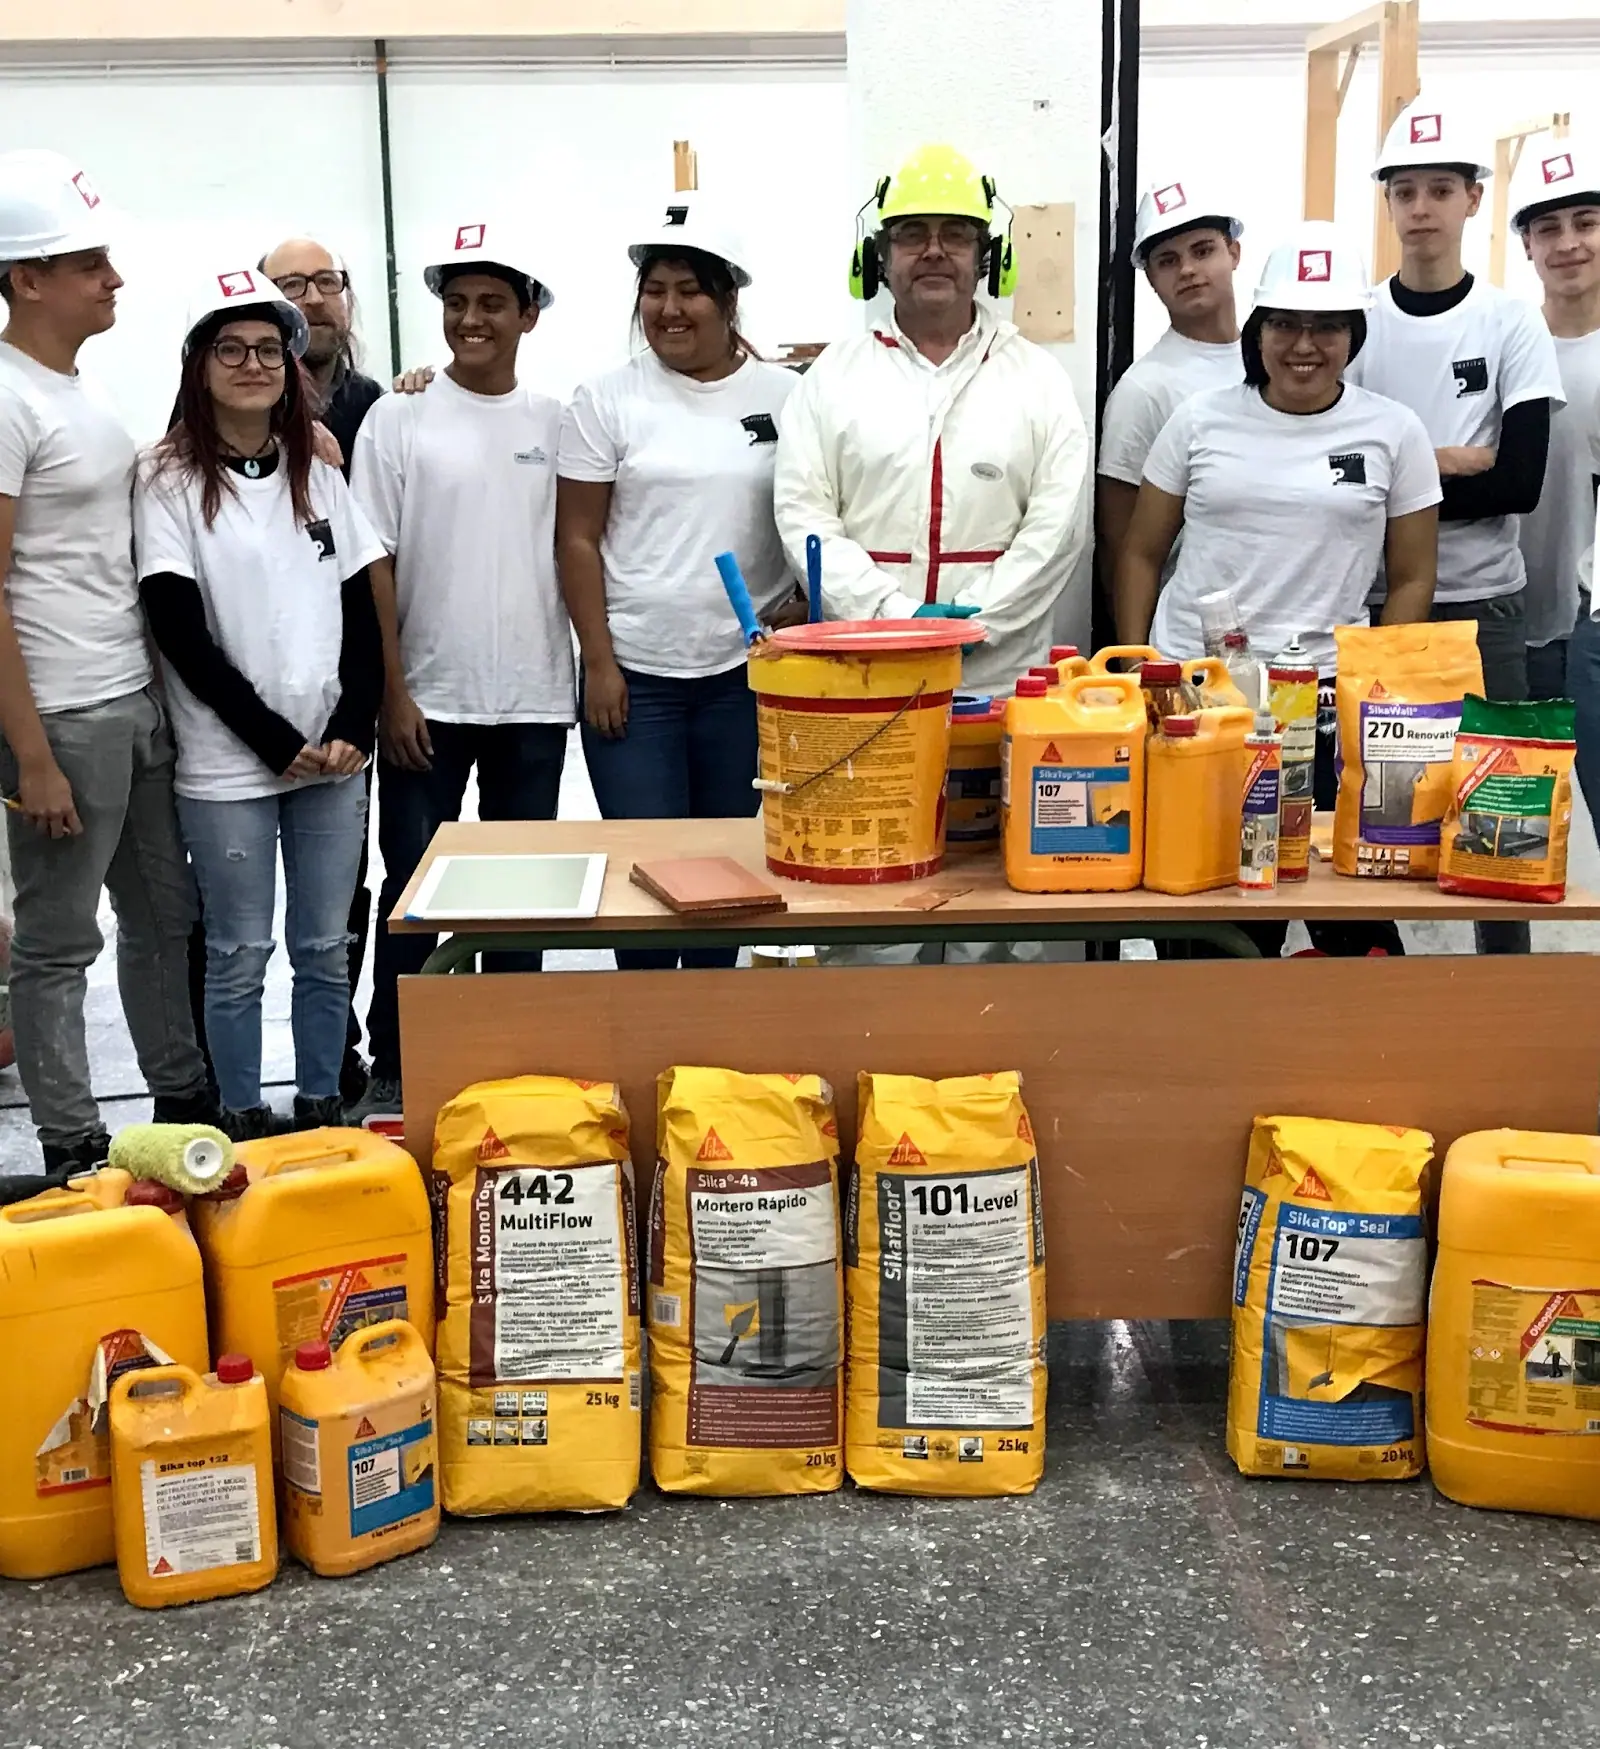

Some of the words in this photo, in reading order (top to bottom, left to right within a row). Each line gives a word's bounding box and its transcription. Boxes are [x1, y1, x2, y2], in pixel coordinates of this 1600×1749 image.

[1368, 722, 1404, 738] 270
[1544, 764, 1550, 774] 2
[1038, 784, 1060, 796] 107
[500, 1173, 574, 1206] 442
[1300, 1176, 1326, 1198] Sika
[696, 1198, 754, 1214] Mortero
[758, 1194, 808, 1214] Rápido
[912, 1184, 969, 1216] 101
[974, 1190, 1018, 1213] Level
[500, 1212, 592, 1230] MultiFlow
[1359, 1220, 1390, 1234] Seal
[1286, 1234, 1340, 1262] 107
[476, 1268, 493, 1305] Sika
[1530, 1294, 1564, 1337] Oleoplast
[586, 1392, 602, 1406] 25
[604, 1390, 620, 1408] kg
[998, 1438, 1013, 1452] 25
[1014, 1438, 1028, 1454] kg
[160, 1463, 184, 1472] Sika
[187, 1460, 206, 1468] top
[209, 1454, 228, 1464] 122
[806, 1454, 822, 1466] 20
[823, 1452, 836, 1467] kg
[1381, 1450, 1398, 1463] 20
[1399, 1448, 1415, 1462] kg
[354, 1458, 376, 1475] 107
